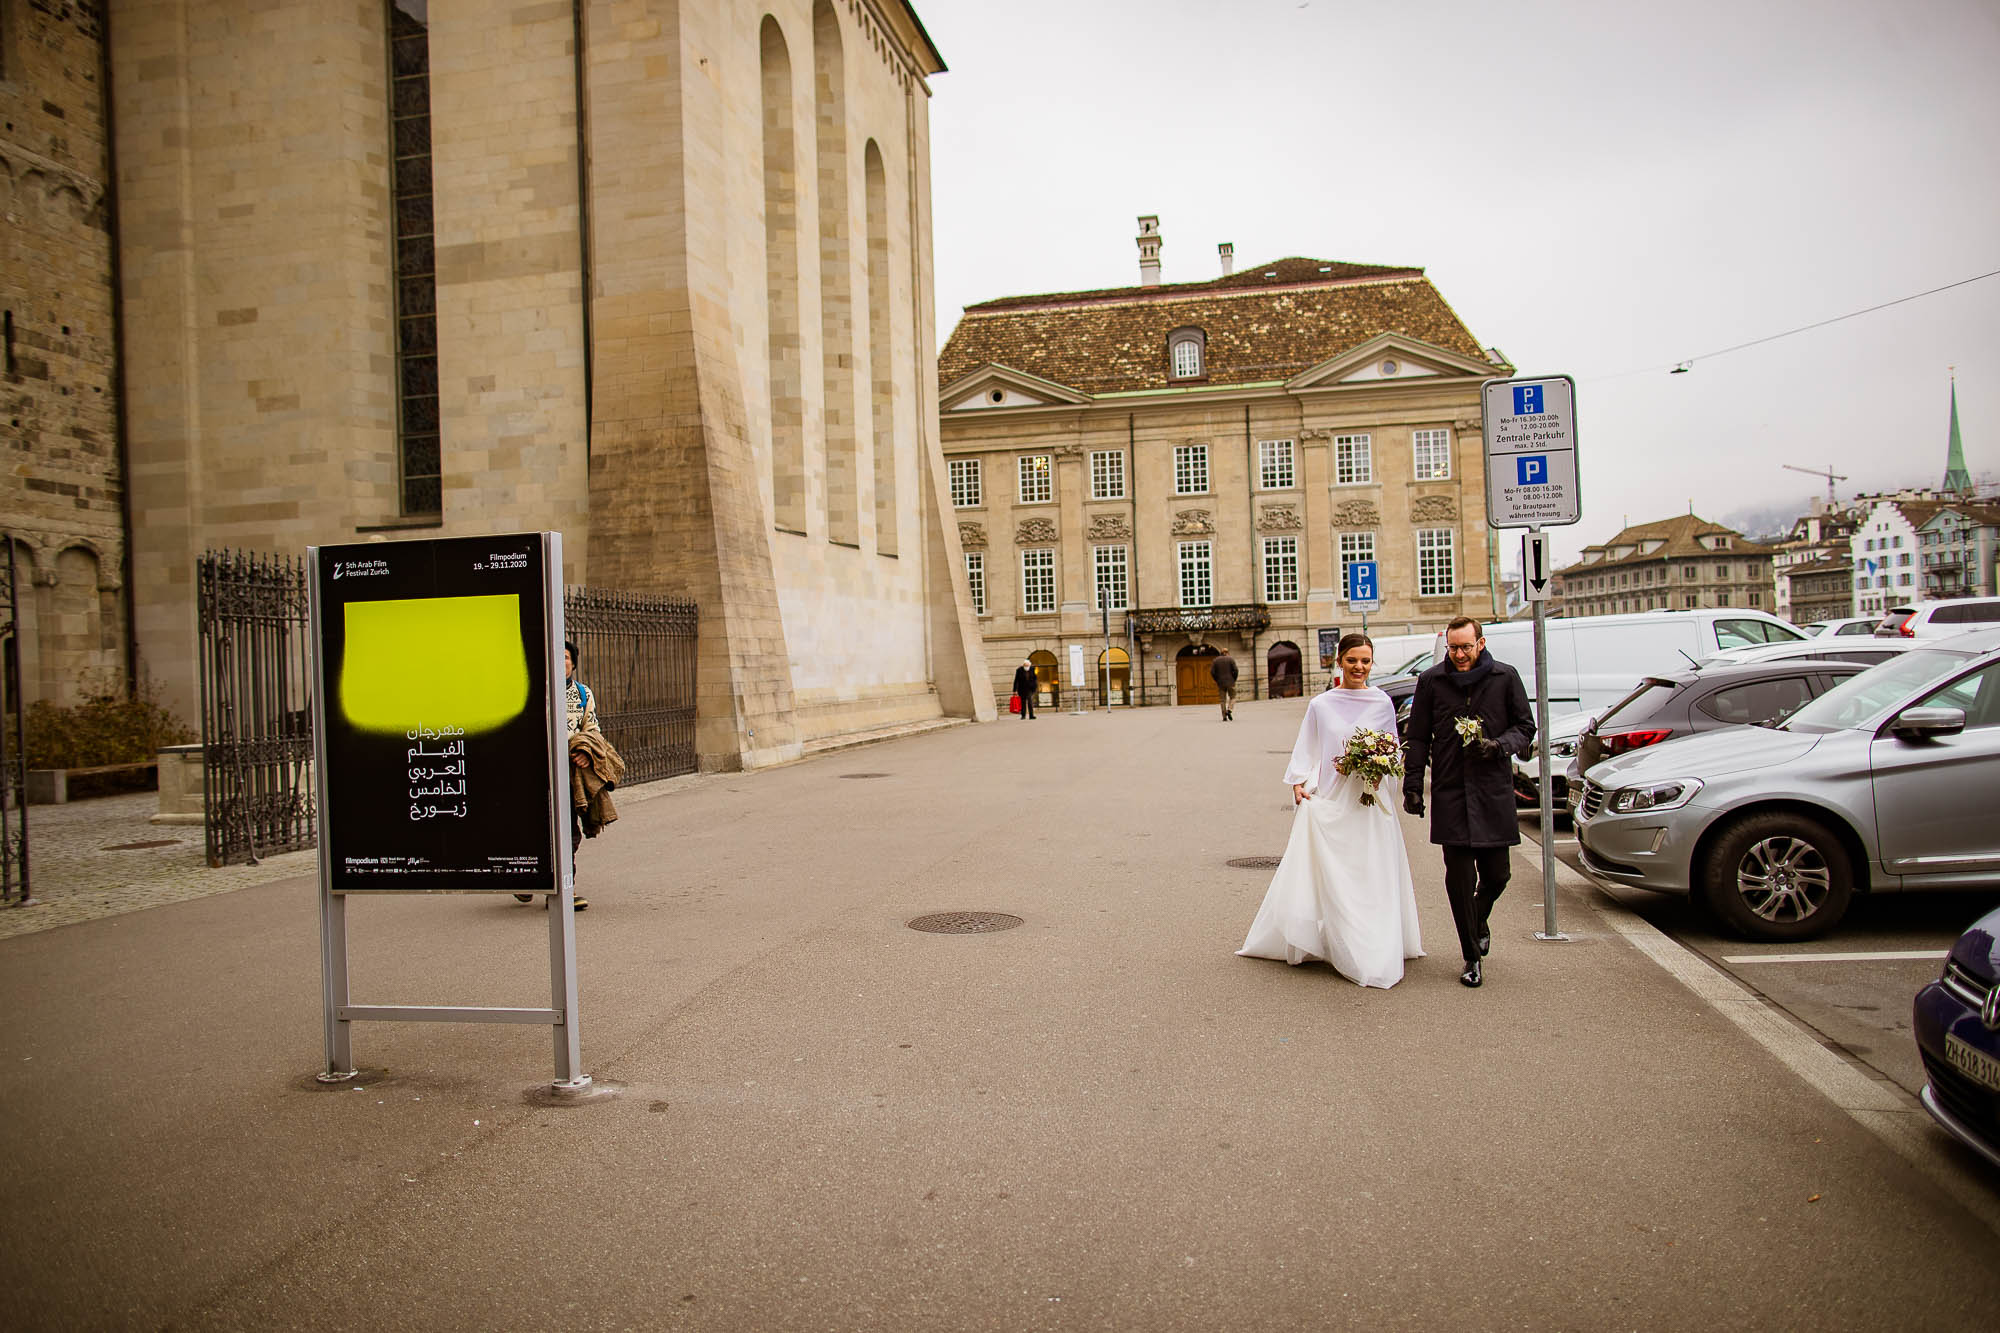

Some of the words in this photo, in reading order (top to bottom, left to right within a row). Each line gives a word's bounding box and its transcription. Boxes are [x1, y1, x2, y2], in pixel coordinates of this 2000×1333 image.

[1524, 388, 1534, 403] P
[1500, 417, 1518, 425] Mo-Fr
[1496, 432, 1531, 443] Zentrale
[1533, 430, 1565, 441] Parkuhr
[1525, 461, 1540, 481] P
[1523, 502, 1556, 511] Brautpaare
[1509, 511, 1535, 519] während
[1536, 510, 1561, 519] Trauung
[489, 552, 527, 561] Filmpodium
[345, 561, 357, 569] 5th
[357, 560, 373, 568] Arab
[373, 559, 387, 568] Film
[490, 560, 527, 569] 29.11.2020
[346, 569, 369, 577] Festival
[369, 567, 390, 576] Zurich
[1357, 565, 1370, 584] P
[406, 721, 465, 741] مهرجان
[408, 759, 466, 783] العربي
[409, 779, 467, 799] الخامس
[345, 857, 379, 866] filmpodium
